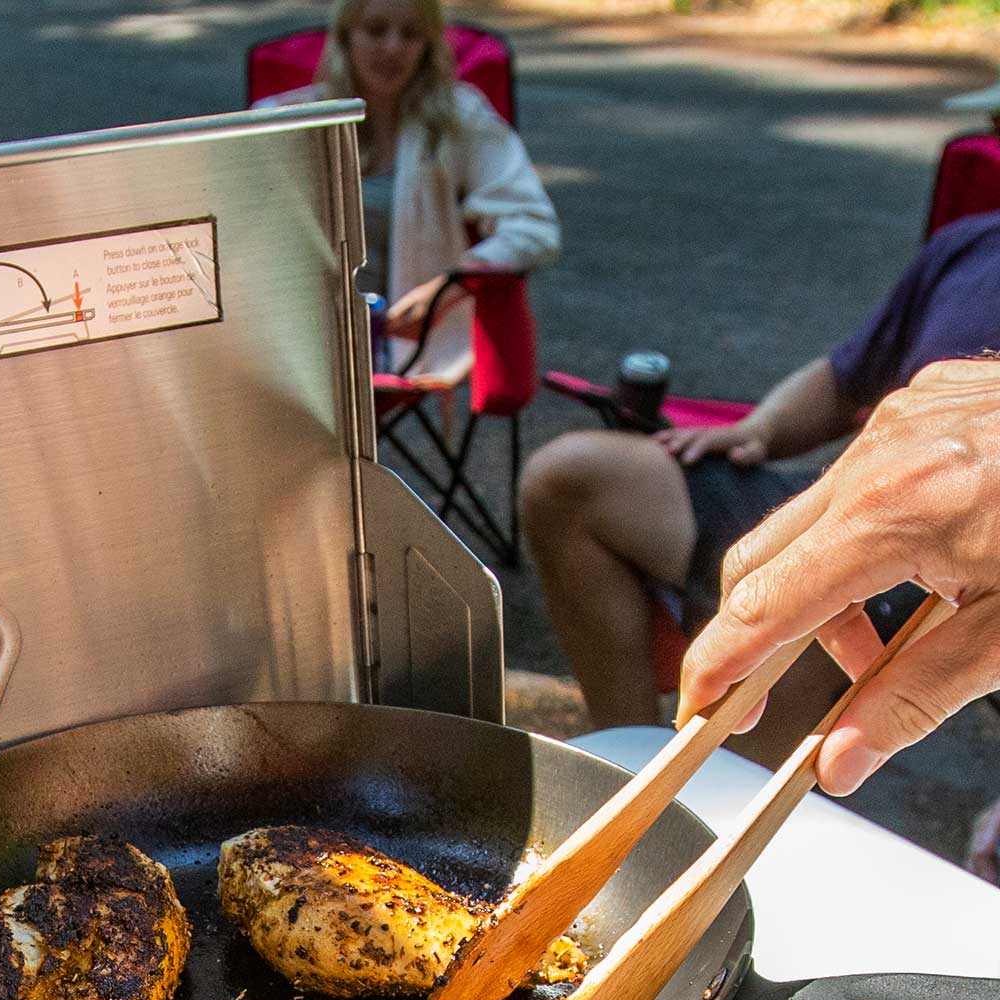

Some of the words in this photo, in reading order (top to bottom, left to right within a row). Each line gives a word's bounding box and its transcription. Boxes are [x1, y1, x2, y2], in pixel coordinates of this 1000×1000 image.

[103, 249, 124, 260] Press
[125, 246, 147, 257] down
[148, 245, 158, 254] on
[73, 269, 79, 278] A
[106, 264, 132, 276] button
[133, 262, 141, 271] to
[142, 259, 161, 270] close
[17, 278, 24, 288] B
[106, 281, 137, 295] Appuyer
[139, 279, 150, 288] sur
[151, 276, 160, 286] le
[160, 273, 185, 285] bouton
[107, 294, 150, 309] verrouillage
[150, 291, 176, 302] orange
[177, 288, 194, 298] pour
[108, 310, 133, 323] fermer
[134, 309, 142, 319] le
